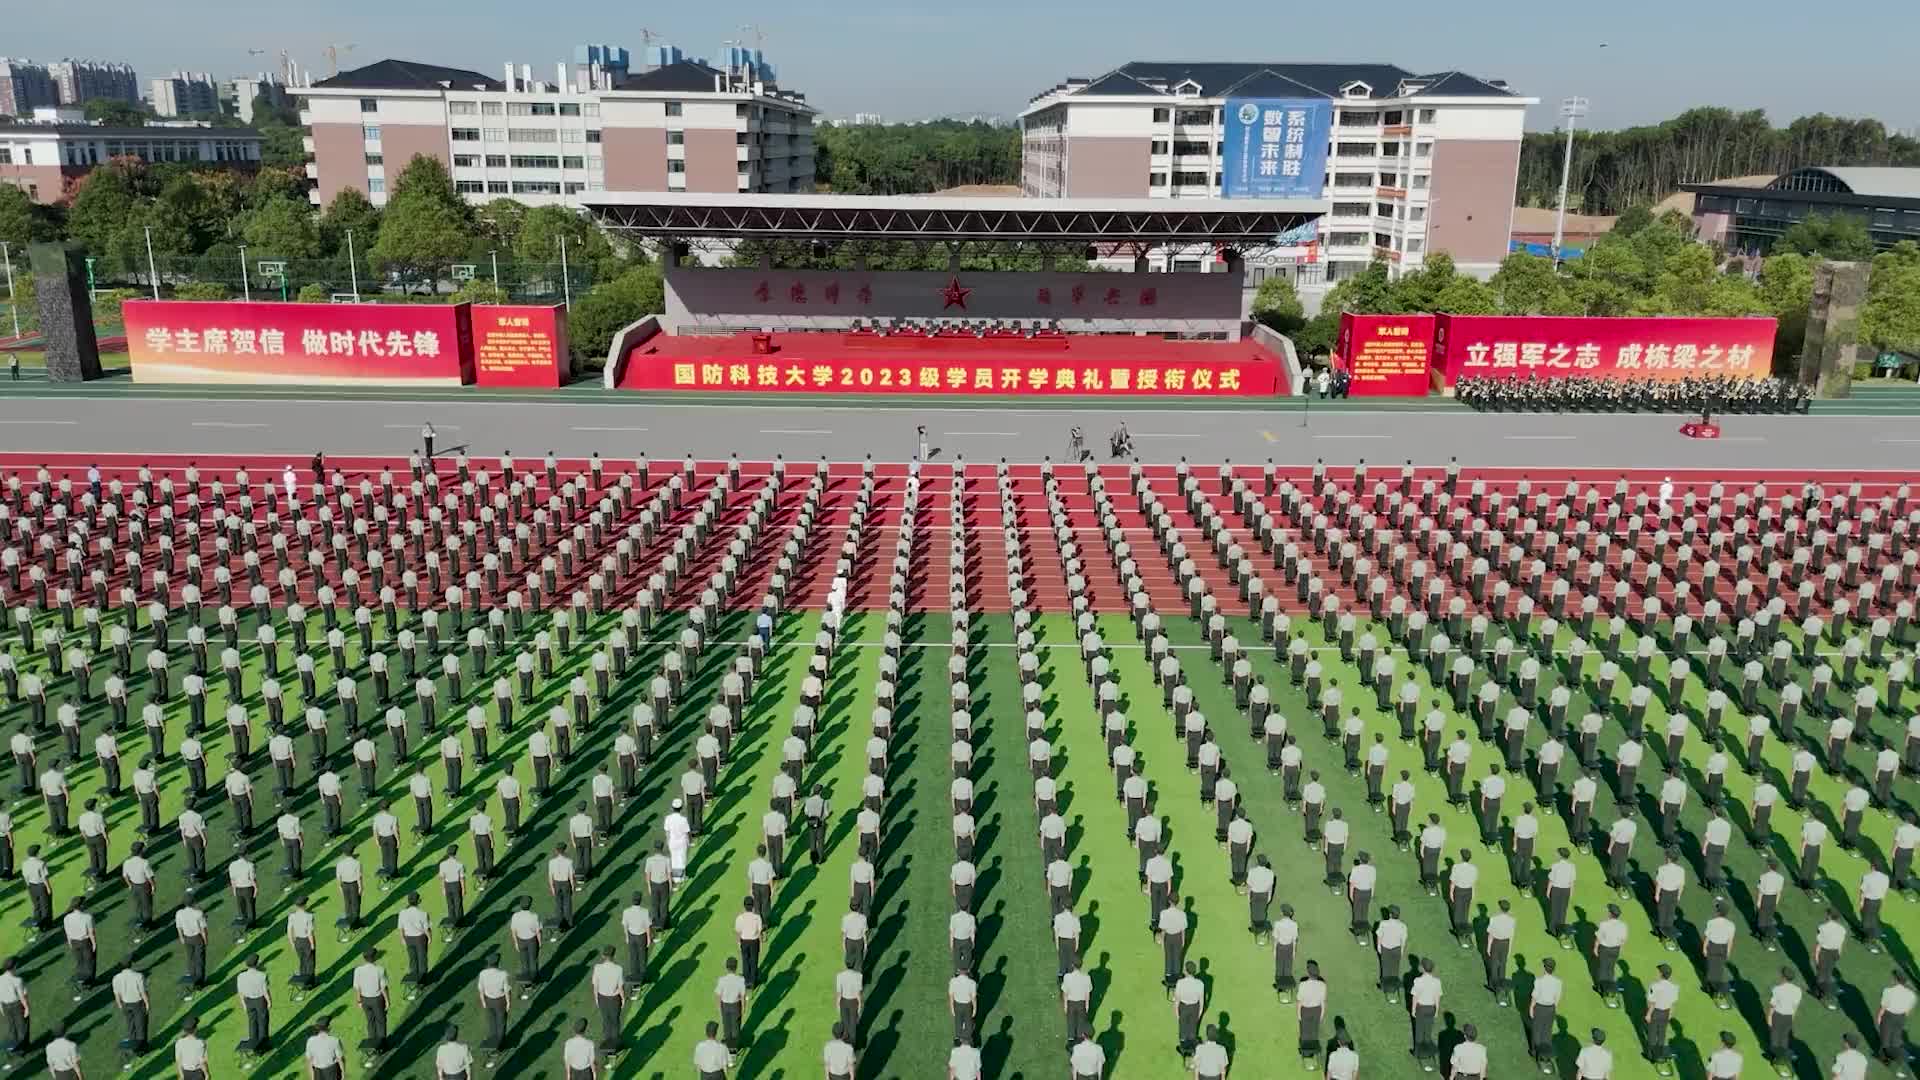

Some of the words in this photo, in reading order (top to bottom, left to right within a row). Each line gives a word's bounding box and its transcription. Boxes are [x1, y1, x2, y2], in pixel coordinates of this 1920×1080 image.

[1282, 110, 1306, 176] 系统制胜
[145, 327, 285, 355] 学主席贺信
[302, 329, 441, 358] 做时代先锋
[1464, 342, 1602, 369] 立强军之志
[1616, 343, 1755, 369] 成栋梁之材
[674, 363, 1241, 391] 国防科技大学2023级学员开学典礼暨授衔仪式
